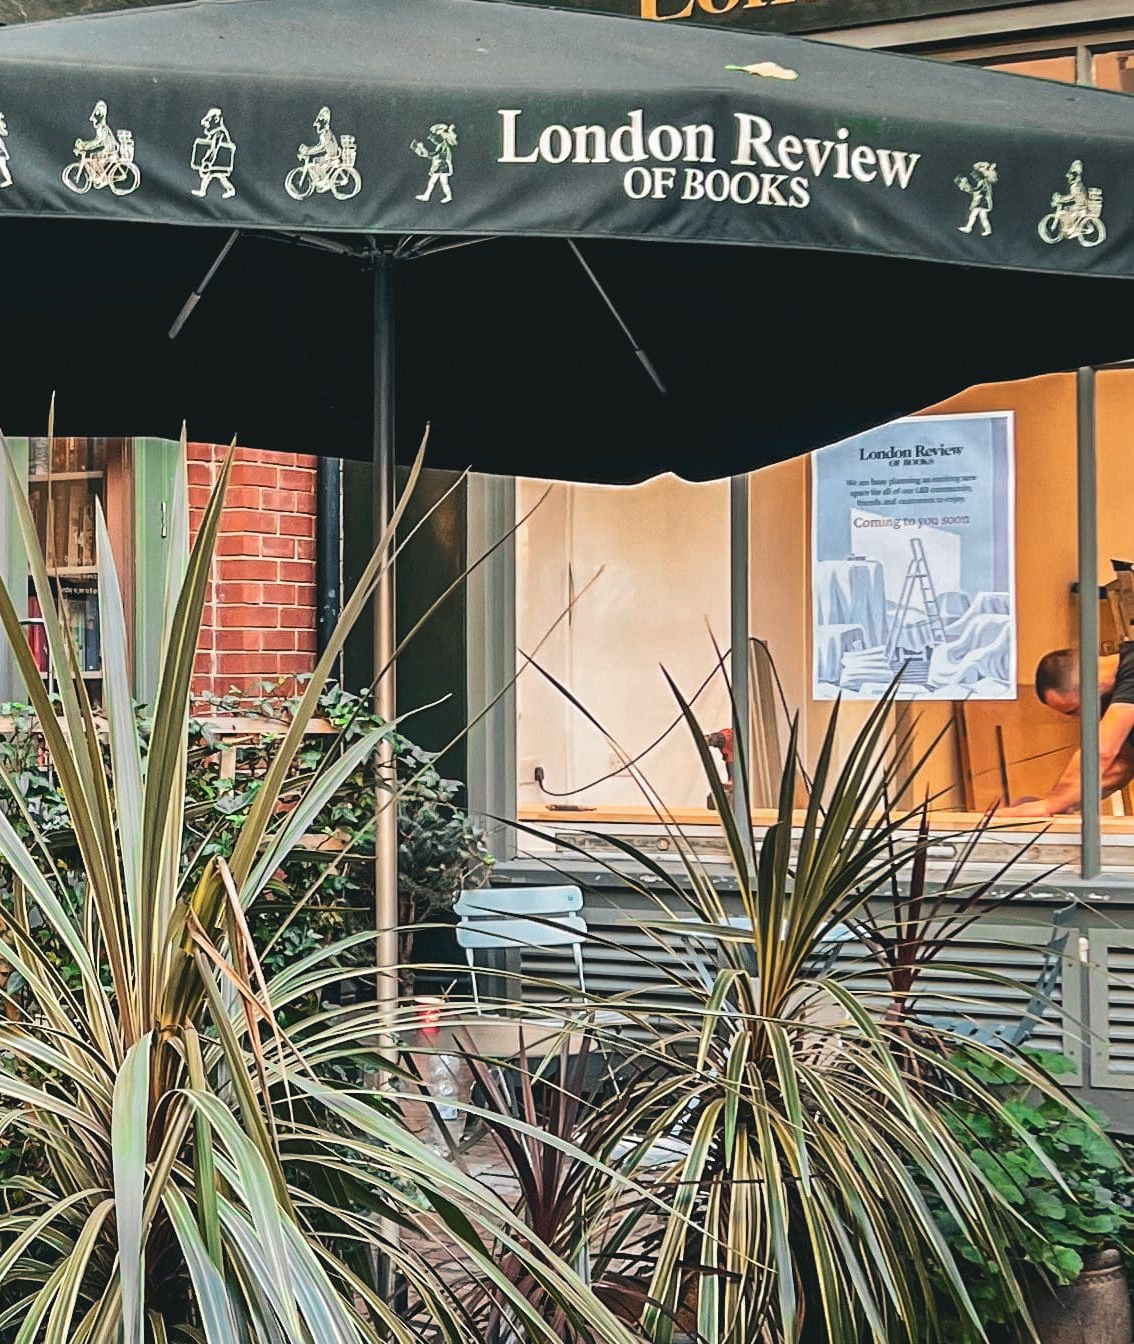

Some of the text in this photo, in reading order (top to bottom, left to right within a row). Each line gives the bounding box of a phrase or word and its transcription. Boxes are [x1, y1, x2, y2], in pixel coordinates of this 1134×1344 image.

[497, 109, 921, 190] London Review
[623, 166, 811, 208] OF BOOKS
[859, 444, 964, 461] London Review
[888, 458, 934, 467] OF BOOKS
[853, 516, 970, 530] Coming to you soon
